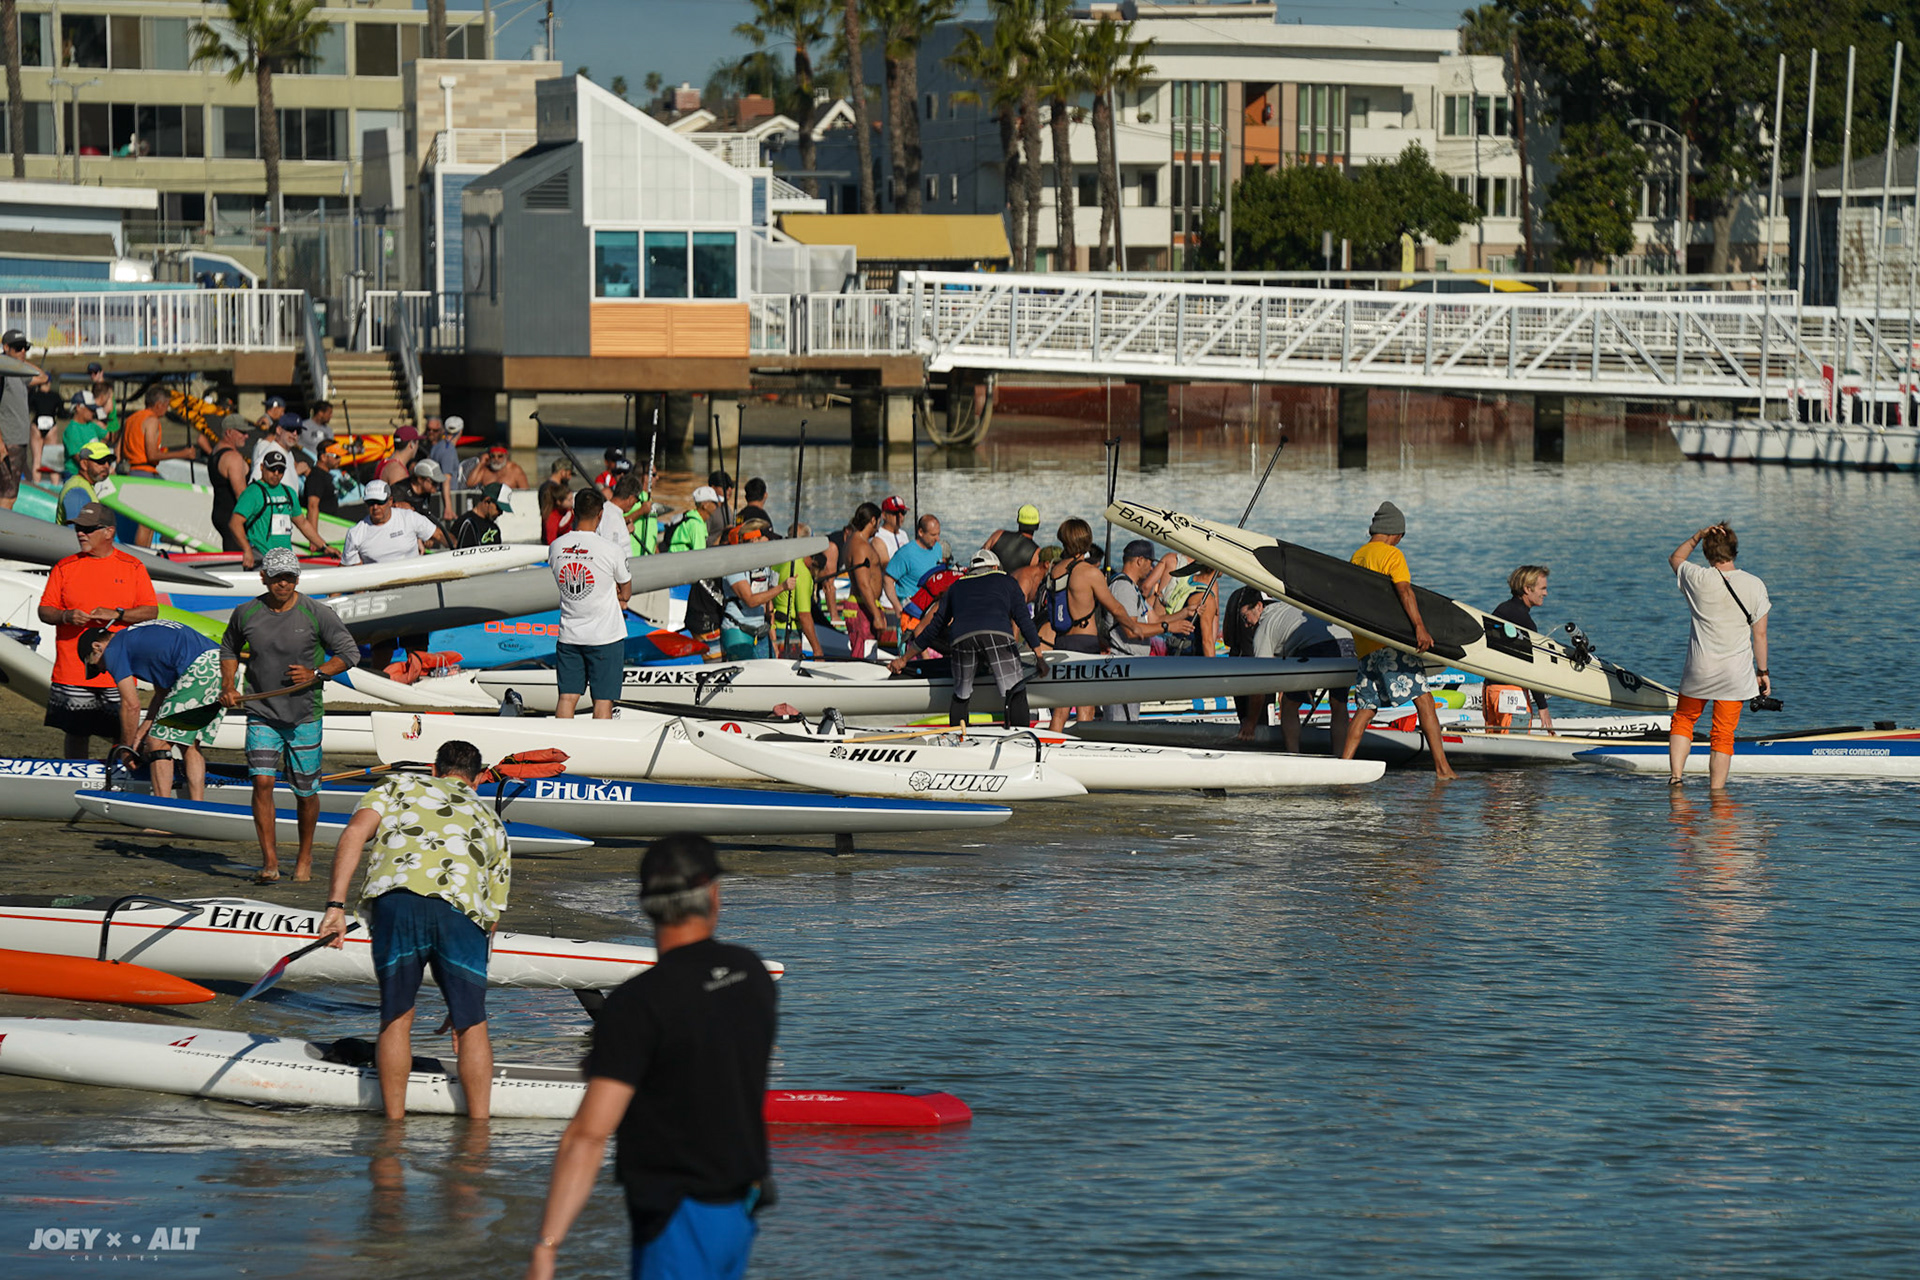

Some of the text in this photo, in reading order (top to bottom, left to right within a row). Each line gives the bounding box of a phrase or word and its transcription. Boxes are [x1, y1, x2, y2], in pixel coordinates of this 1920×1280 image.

[1118, 506, 1172, 541] BARK
[1052, 664, 1131, 680] EHUKAI
[1507, 695, 1519, 706] 199
[849, 749, 918, 763] HUKI
[1849, 748, 1891, 756] CONNECTION
[535, 780, 633, 802] EHUKAI
[927, 773, 1008, 792] HUKI
[208, 906, 320, 934] EHUKA
